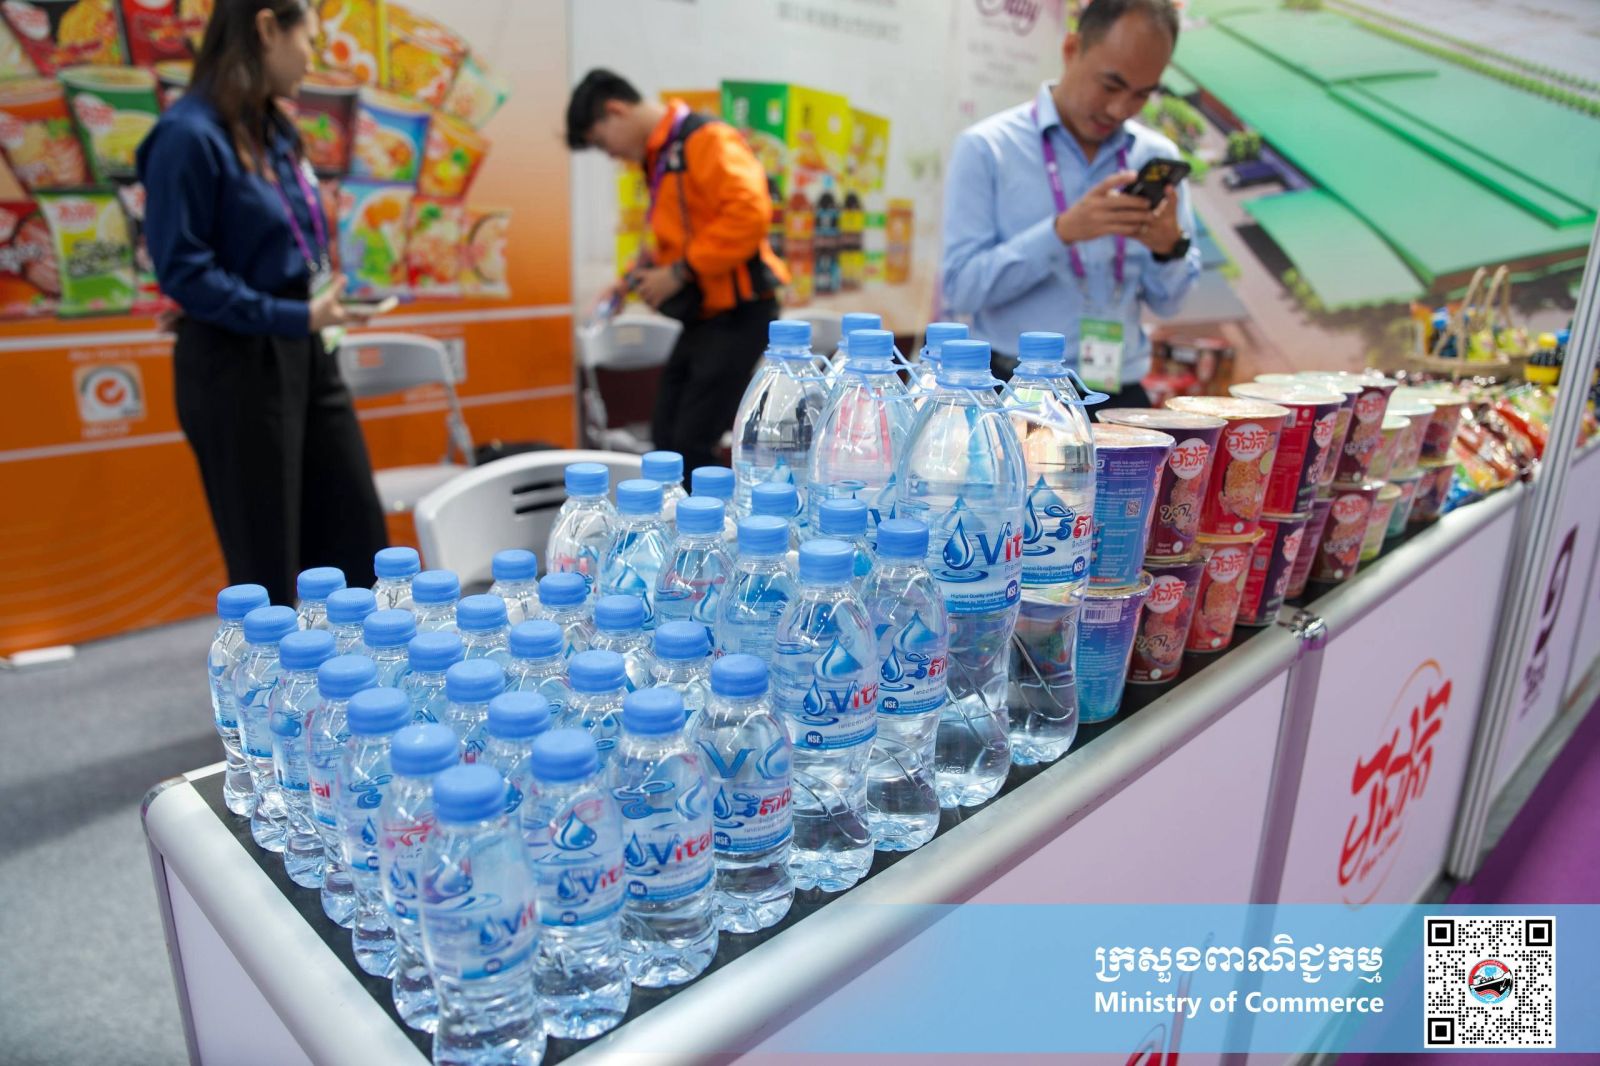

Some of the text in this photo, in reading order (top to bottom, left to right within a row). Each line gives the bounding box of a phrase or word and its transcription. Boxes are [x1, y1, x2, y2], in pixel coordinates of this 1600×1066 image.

[884, 699, 897, 709] NSF
[807, 735, 822, 744] NSF
[715, 834, 730, 846] NSF
